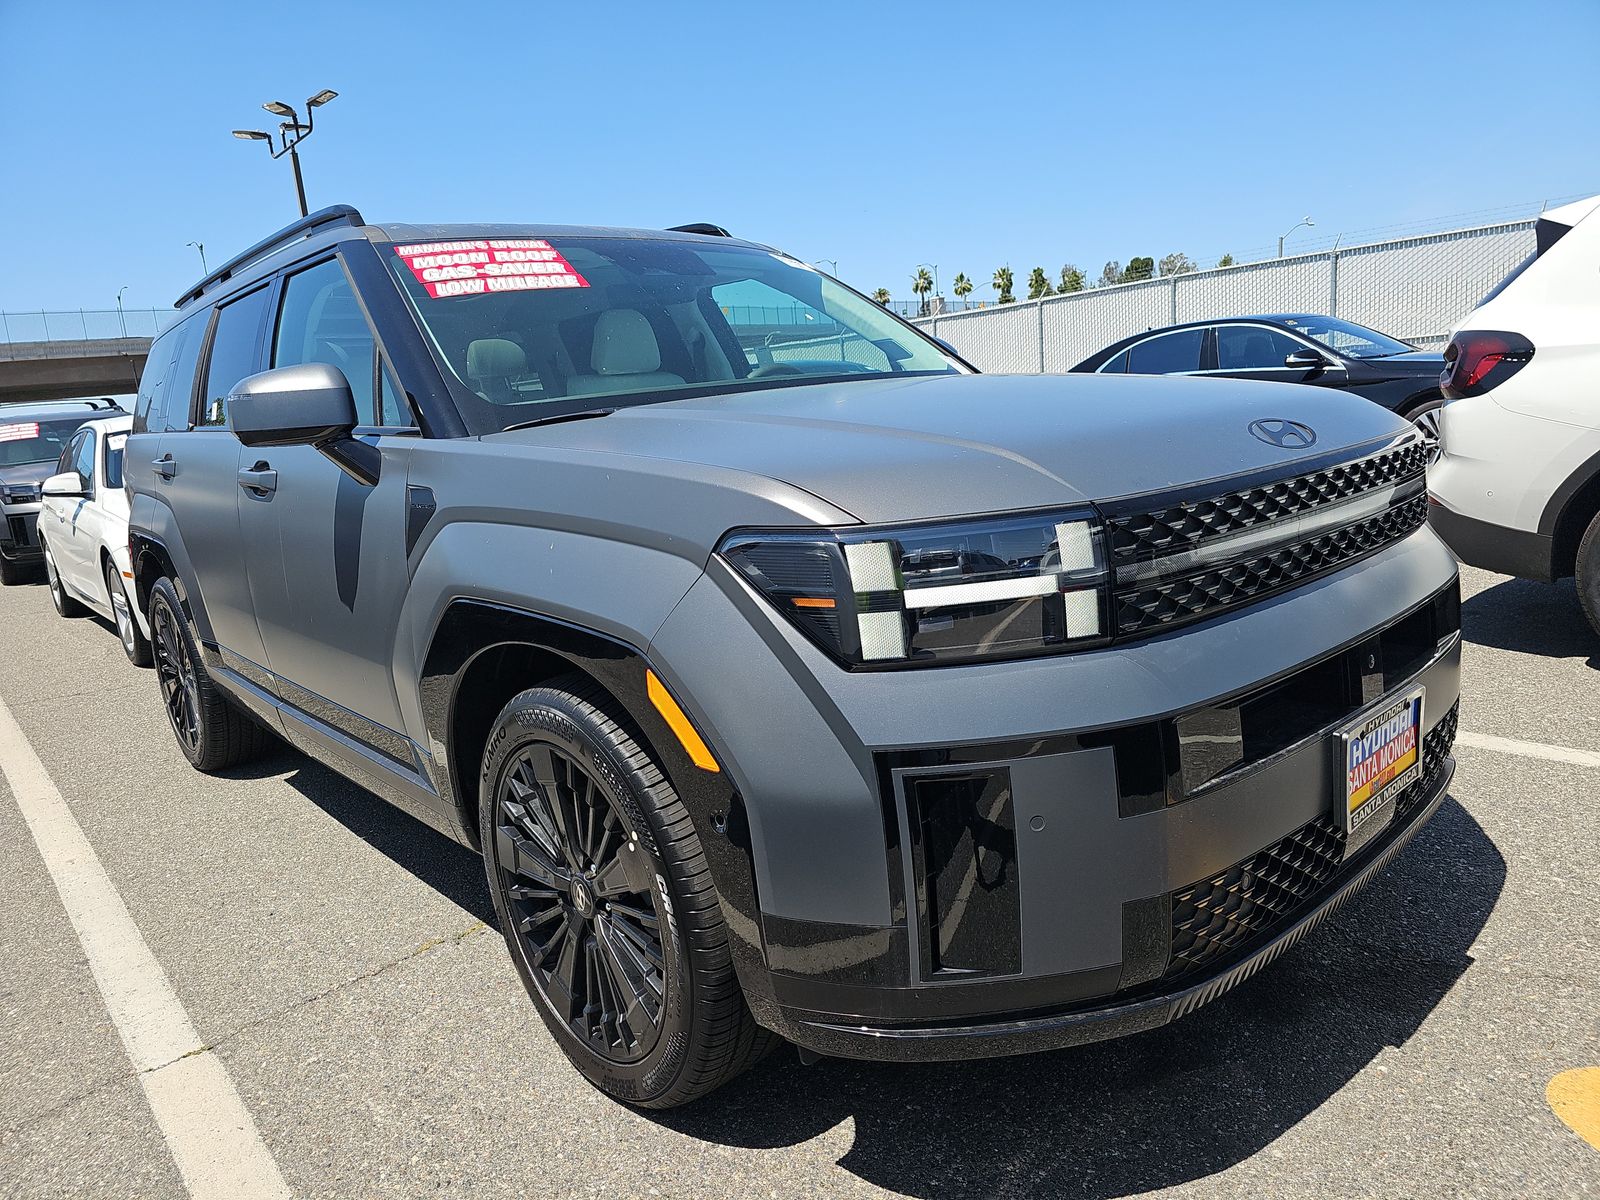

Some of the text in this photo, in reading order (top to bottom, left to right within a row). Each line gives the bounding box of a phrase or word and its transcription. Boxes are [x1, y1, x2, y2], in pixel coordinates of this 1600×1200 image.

[398, 239, 551, 256] MANAGER'S SPECIAL
[412, 250, 558, 269] MOON ROOF
[421, 261, 567, 281] GAS-SAVER
[434, 274, 580, 297] LOW MILEAGE
[1367, 702, 1405, 731] HYUNDAI
[1353, 707, 1413, 767] HYUNDAI
[482, 725, 507, 783] KUMHO
[1349, 727, 1416, 795] SANTA MONICA
[1352, 768, 1418, 827] SANTA MONICA
